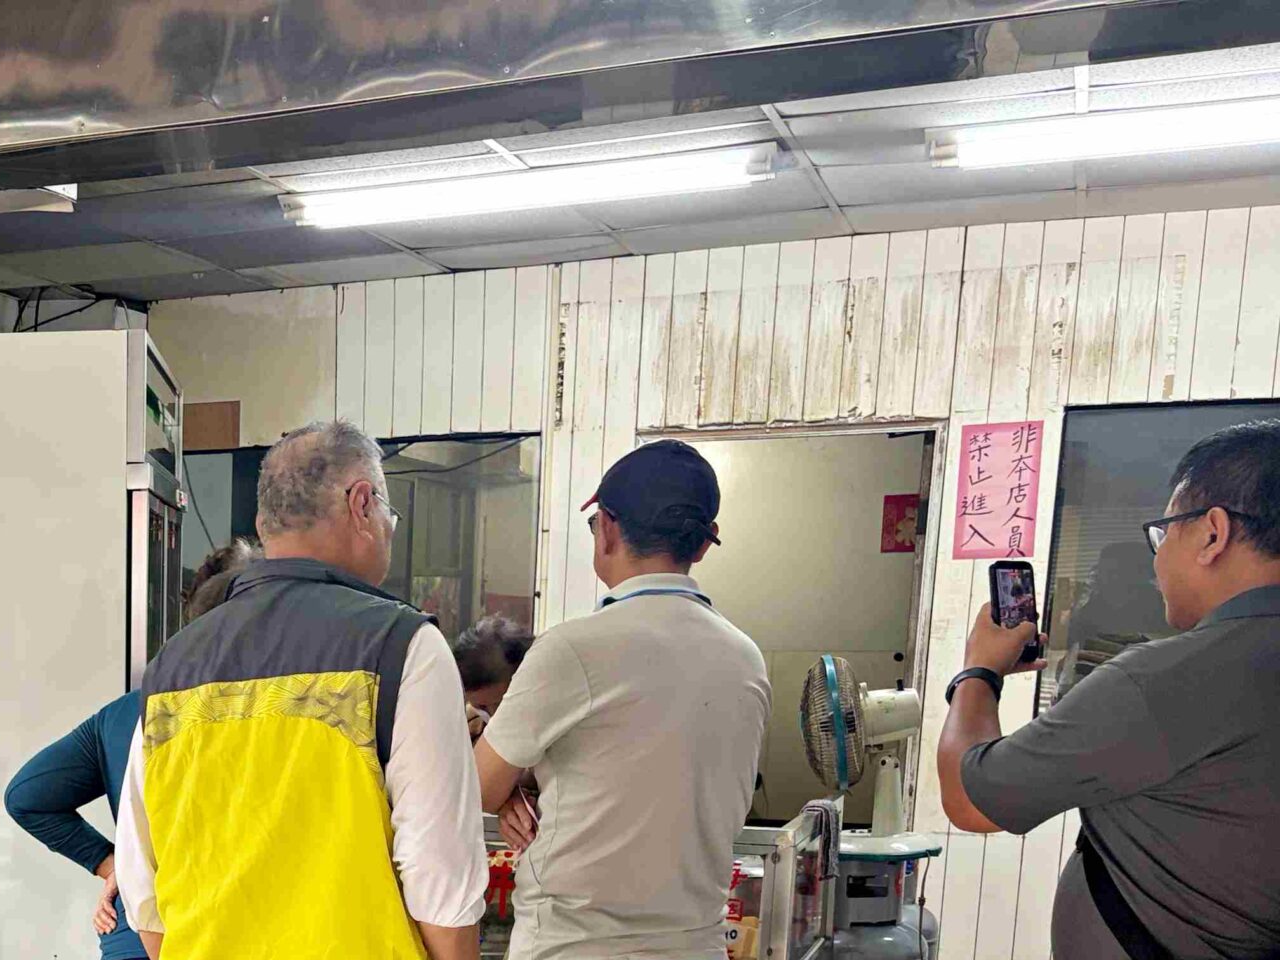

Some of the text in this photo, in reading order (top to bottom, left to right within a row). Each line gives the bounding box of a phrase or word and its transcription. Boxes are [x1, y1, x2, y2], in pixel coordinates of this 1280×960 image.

[958, 432, 996, 548] 禁止進入
[1001, 423, 1038, 558] 非本店人員
